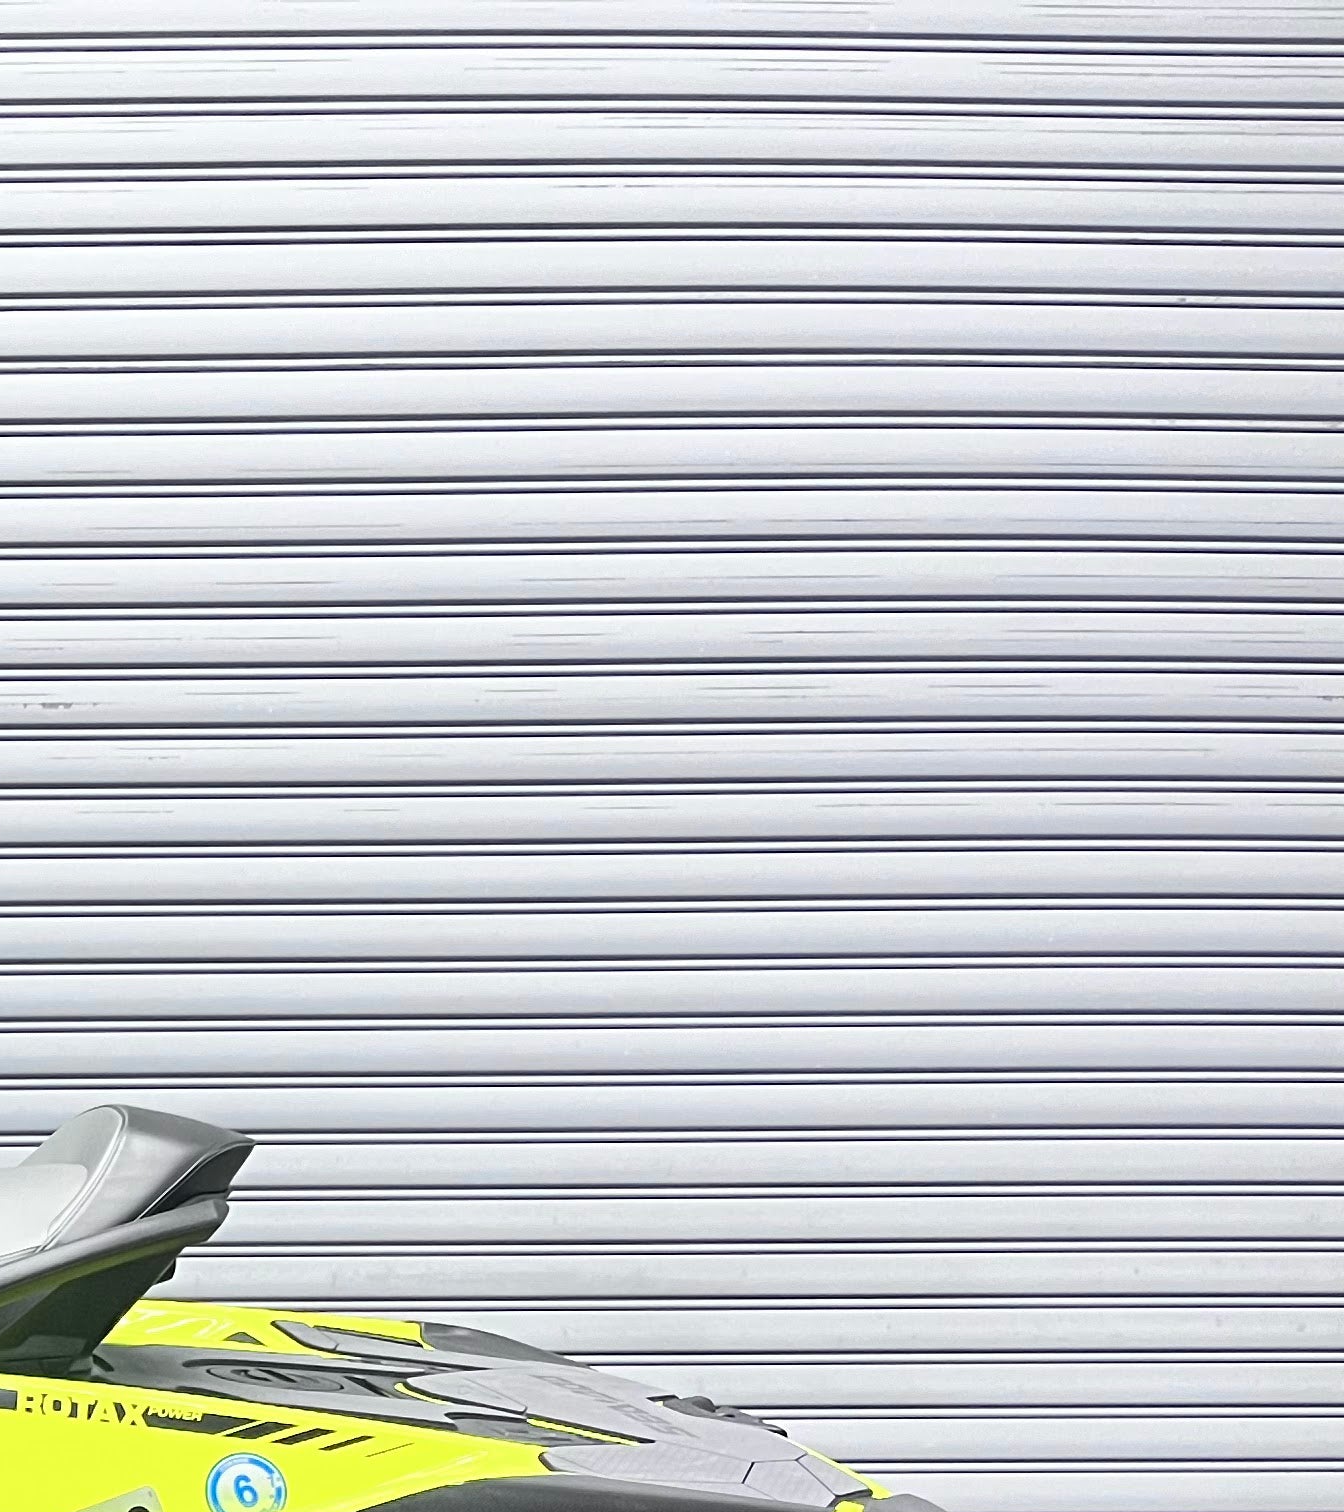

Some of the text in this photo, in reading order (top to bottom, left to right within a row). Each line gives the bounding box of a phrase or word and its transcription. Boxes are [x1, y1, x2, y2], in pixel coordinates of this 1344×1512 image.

[17, 1390, 204, 1427] ROTAX POWER
[233, 1475, 259, 1508] 6
